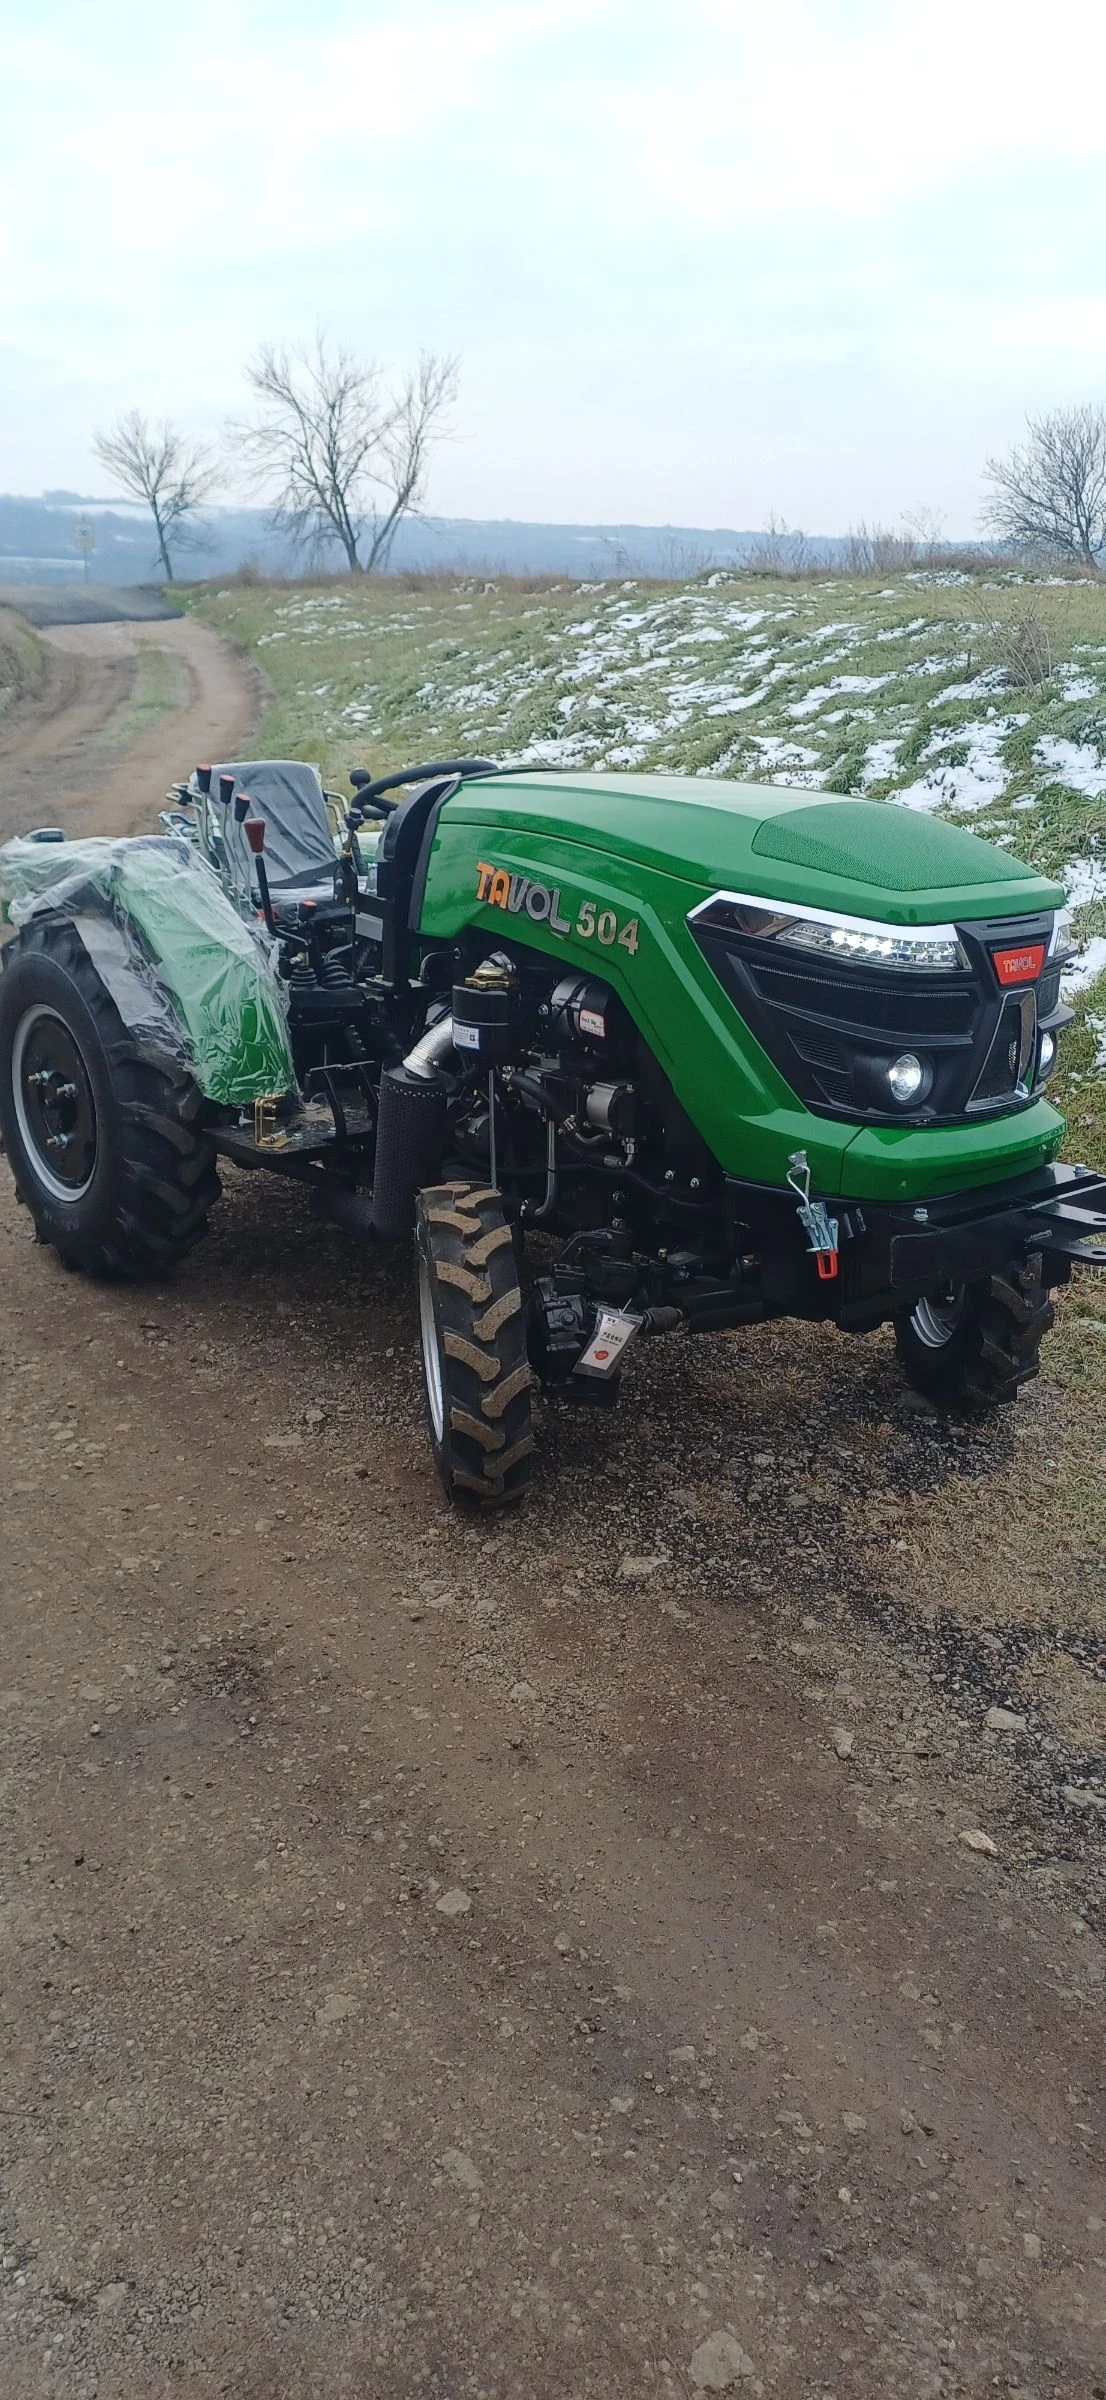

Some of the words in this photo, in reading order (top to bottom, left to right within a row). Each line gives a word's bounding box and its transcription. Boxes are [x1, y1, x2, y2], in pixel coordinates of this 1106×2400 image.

[475, 860, 571, 933] TAVOL
[576, 899, 640, 956] 504
[1002, 955, 1036, 974] TAVOL
